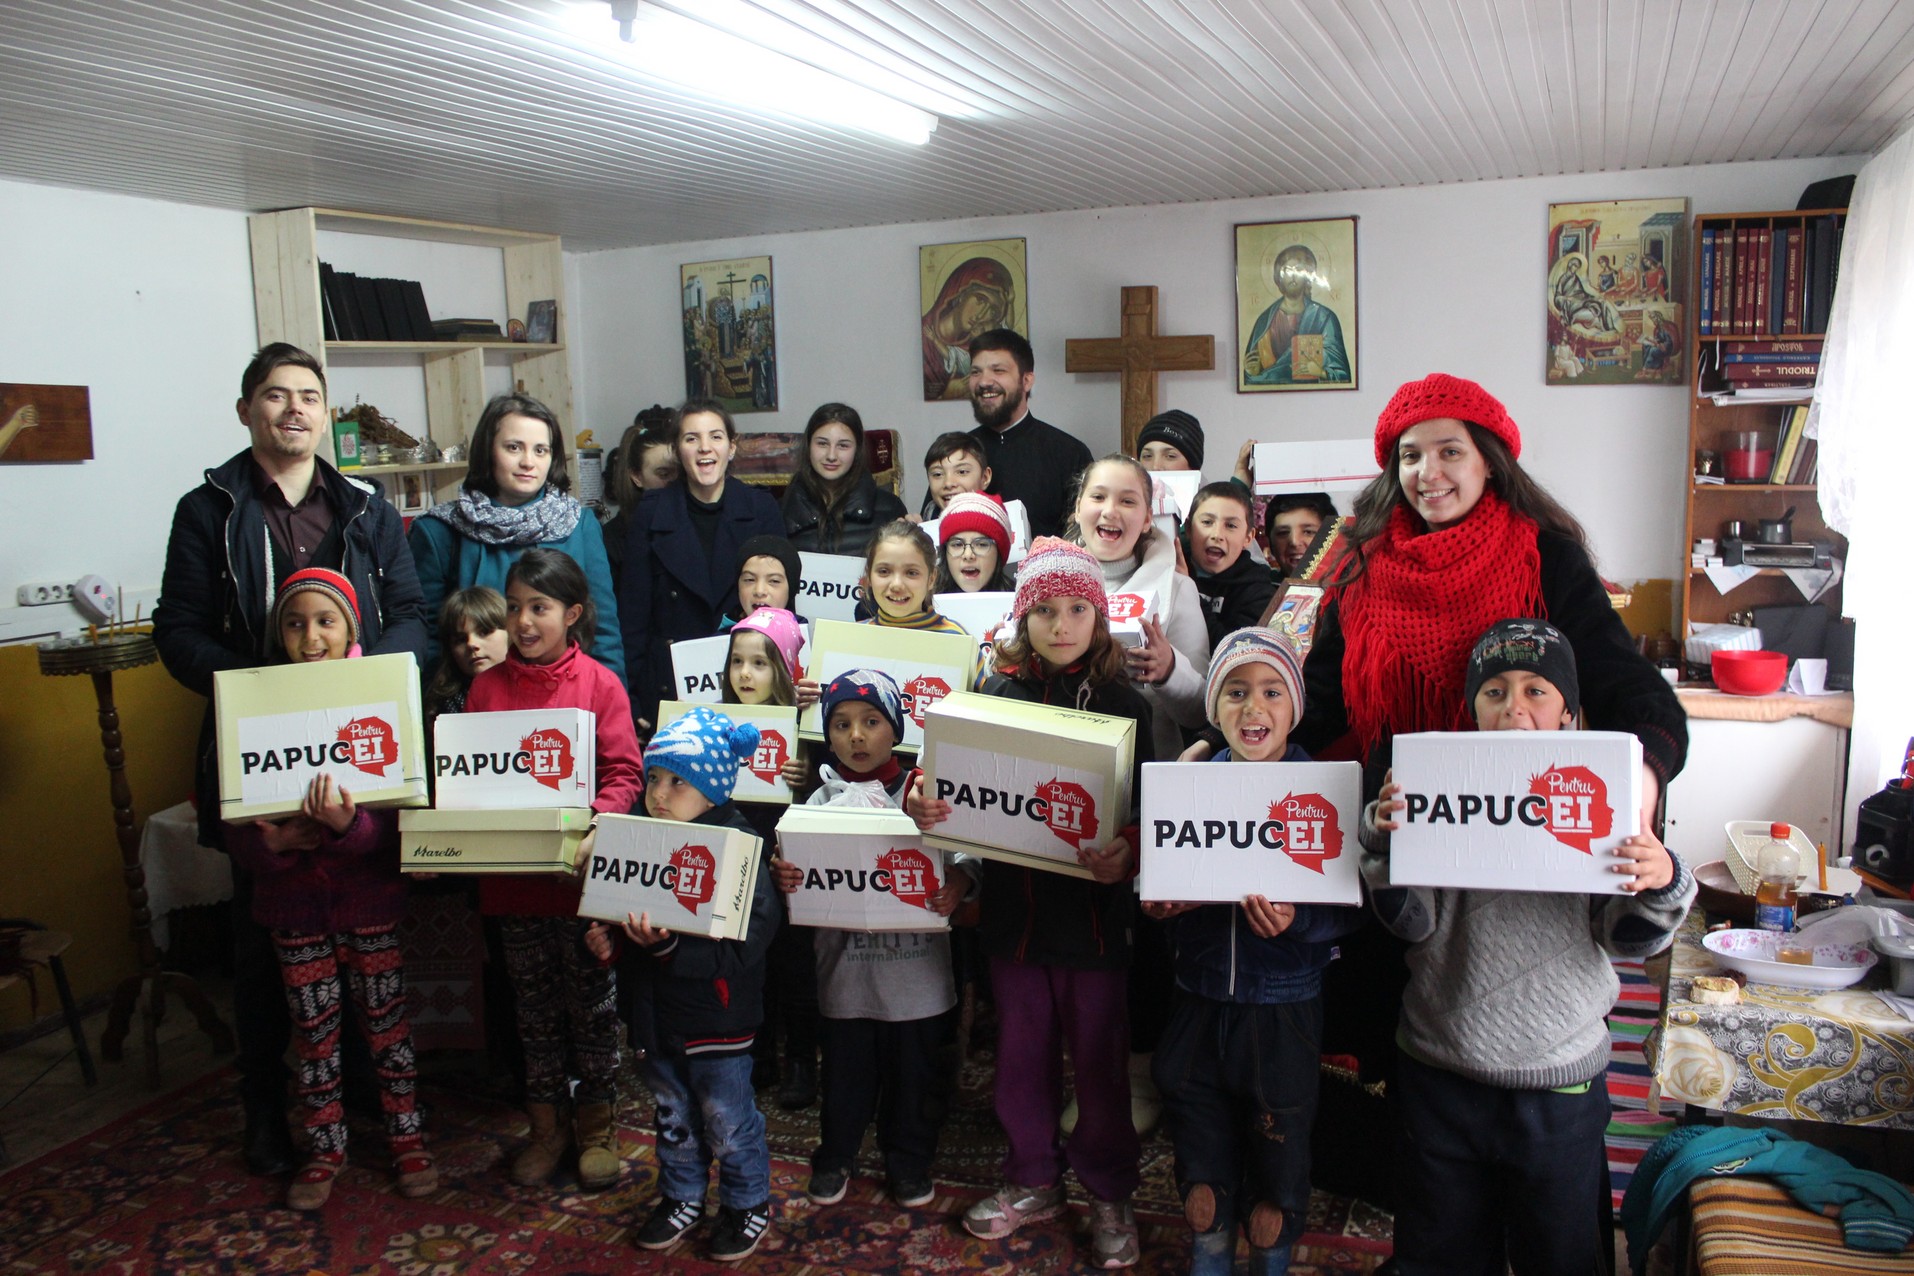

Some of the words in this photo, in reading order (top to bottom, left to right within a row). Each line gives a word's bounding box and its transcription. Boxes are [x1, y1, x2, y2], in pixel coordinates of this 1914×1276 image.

[1776, 366, 1816, 375] TRIODUL
[913, 680, 946, 697] Pentru
[347, 722, 386, 739] Pentru
[530, 733, 564, 750] Pentru
[1543, 772, 1596, 794] Pentru
[1047, 784, 1087, 806] Pentru
[1281, 799, 1329, 819] Pentru
[413, 845, 463, 859] Marelbo
[680, 849, 709, 868] Pentru
[887, 853, 926, 869] Pentru
